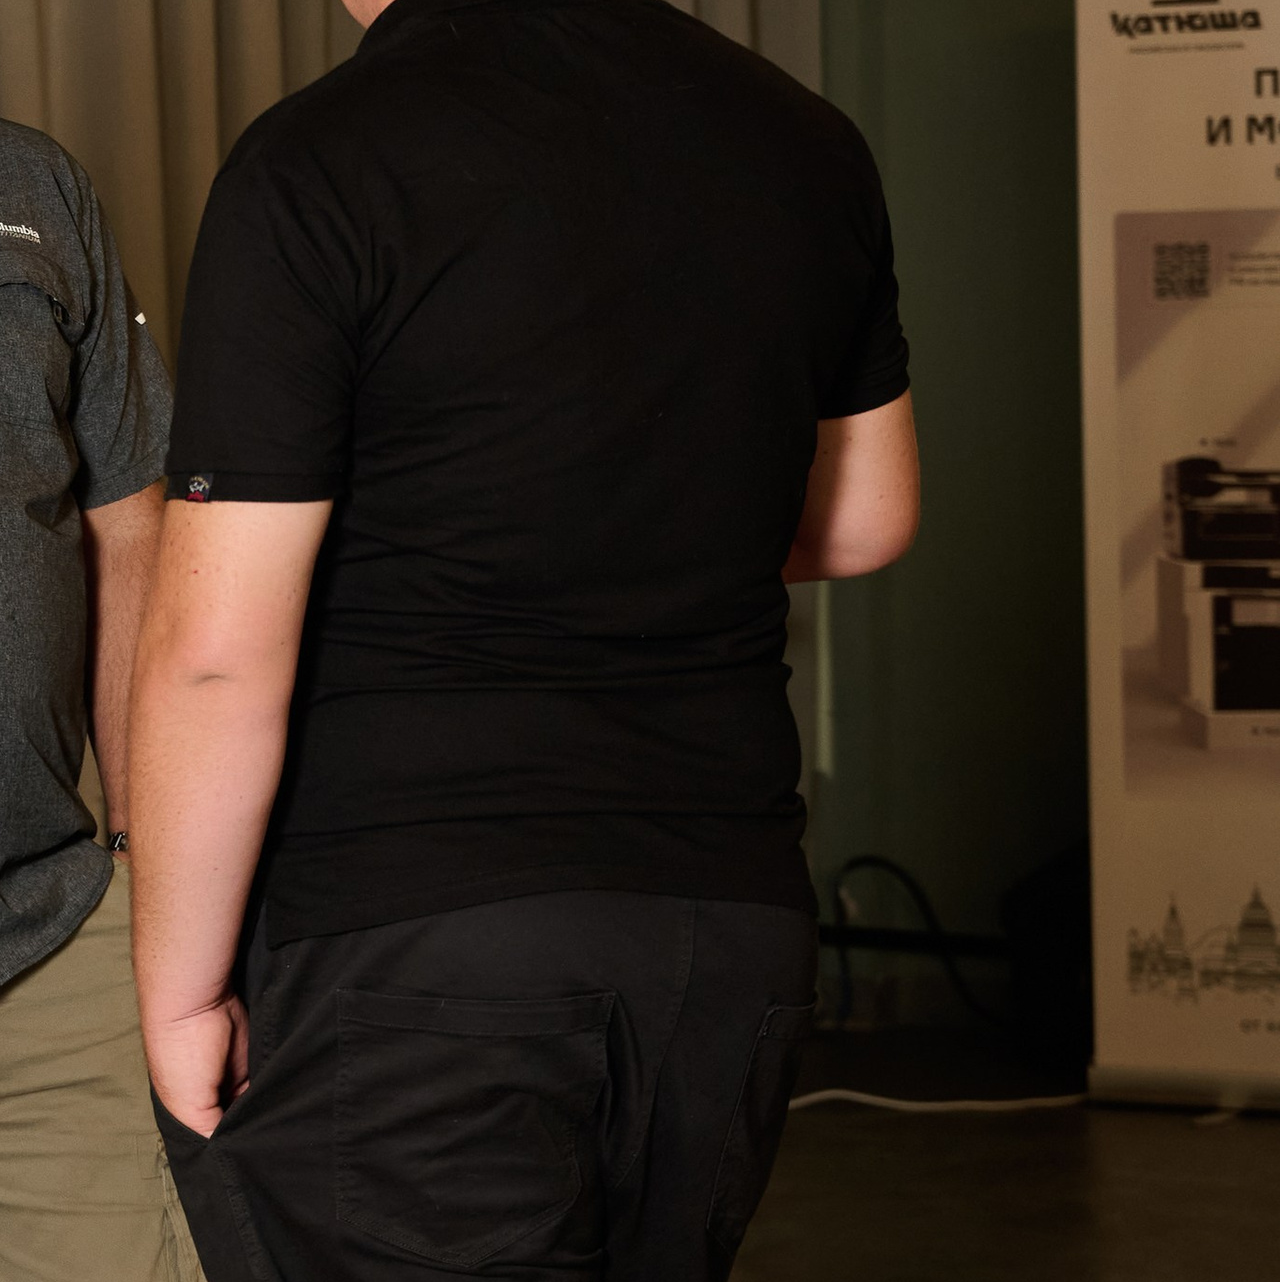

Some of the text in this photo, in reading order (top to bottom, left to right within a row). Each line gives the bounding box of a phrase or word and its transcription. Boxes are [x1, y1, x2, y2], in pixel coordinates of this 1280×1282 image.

[1205, 114, 1280, 146] И М
[0, 230, 41, 244] TITANIUM
